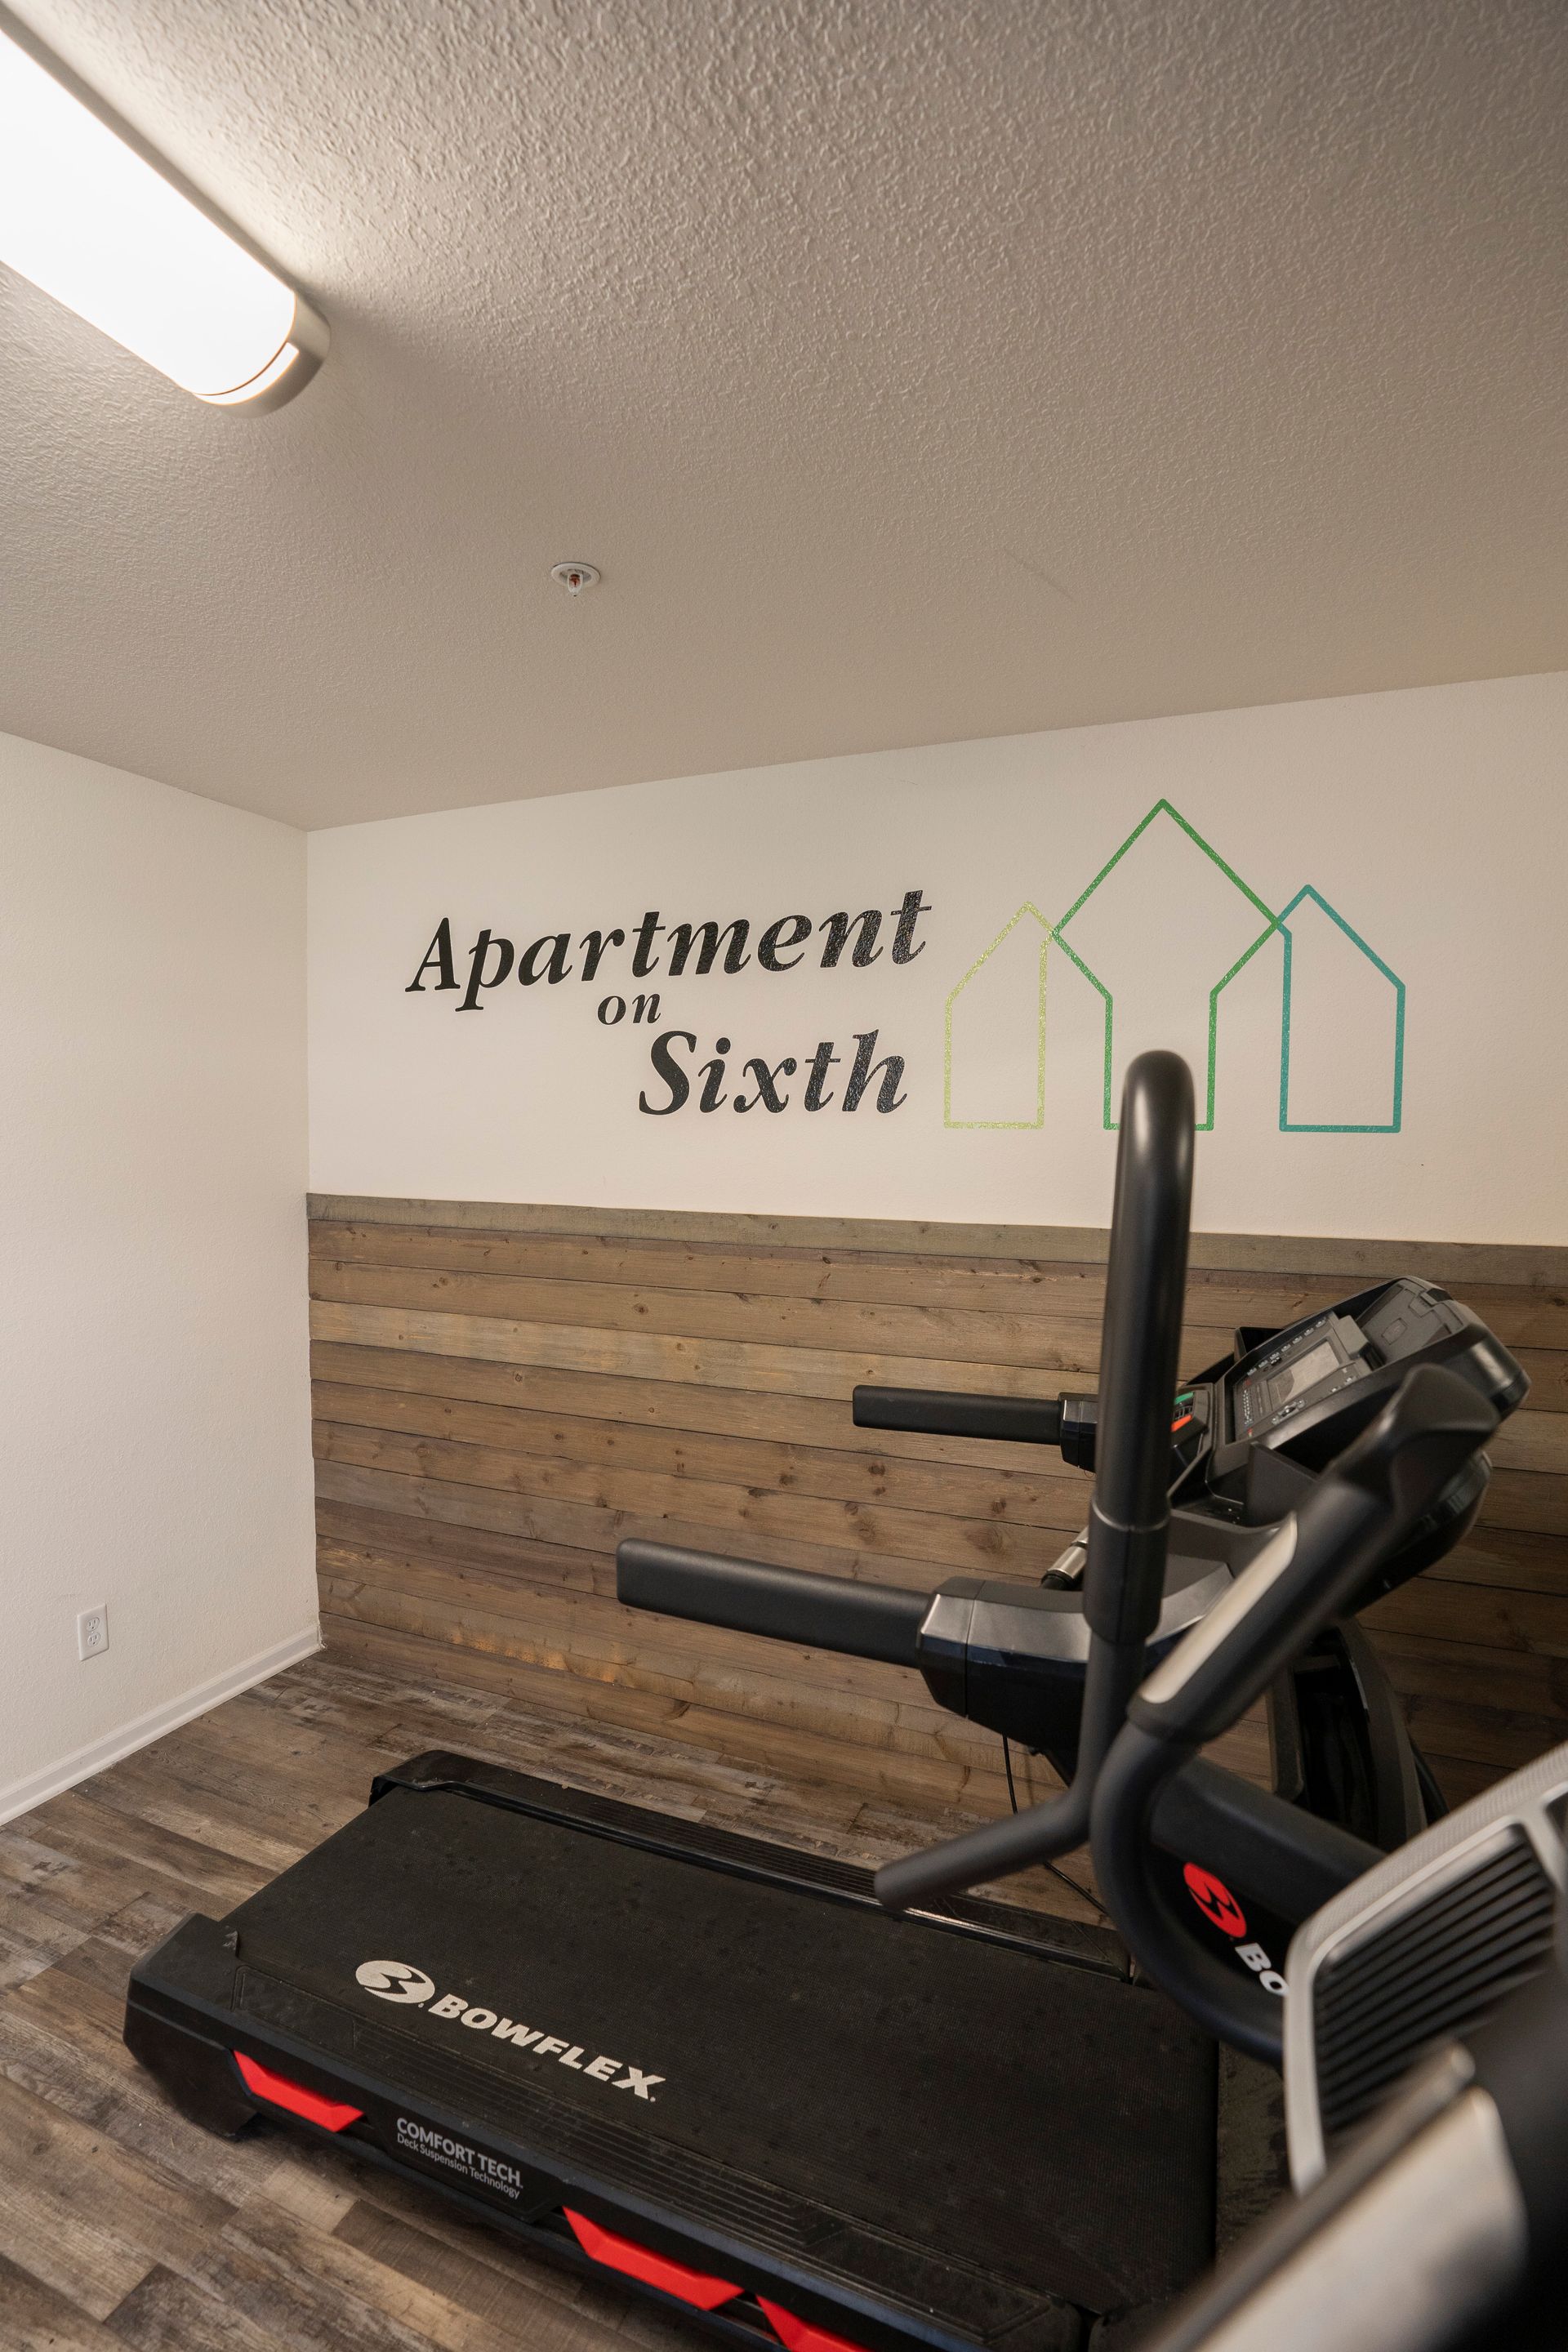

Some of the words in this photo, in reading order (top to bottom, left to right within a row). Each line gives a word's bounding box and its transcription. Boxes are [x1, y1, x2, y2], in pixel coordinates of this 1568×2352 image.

[404, 889, 932, 1012] Apartment
[597, 993, 661, 1025] on
[639, 1029, 907, 1116] Sixth
[427, 1993, 666, 2100] BOWFLEX
[396, 2117, 476, 2165] COMFORT
[477, 2153, 521, 2188] TECH
[397, 2132, 419, 2152] Deck
[419, 2144, 468, 2175] Suspension
[469, 2166, 520, 2200] Technology
